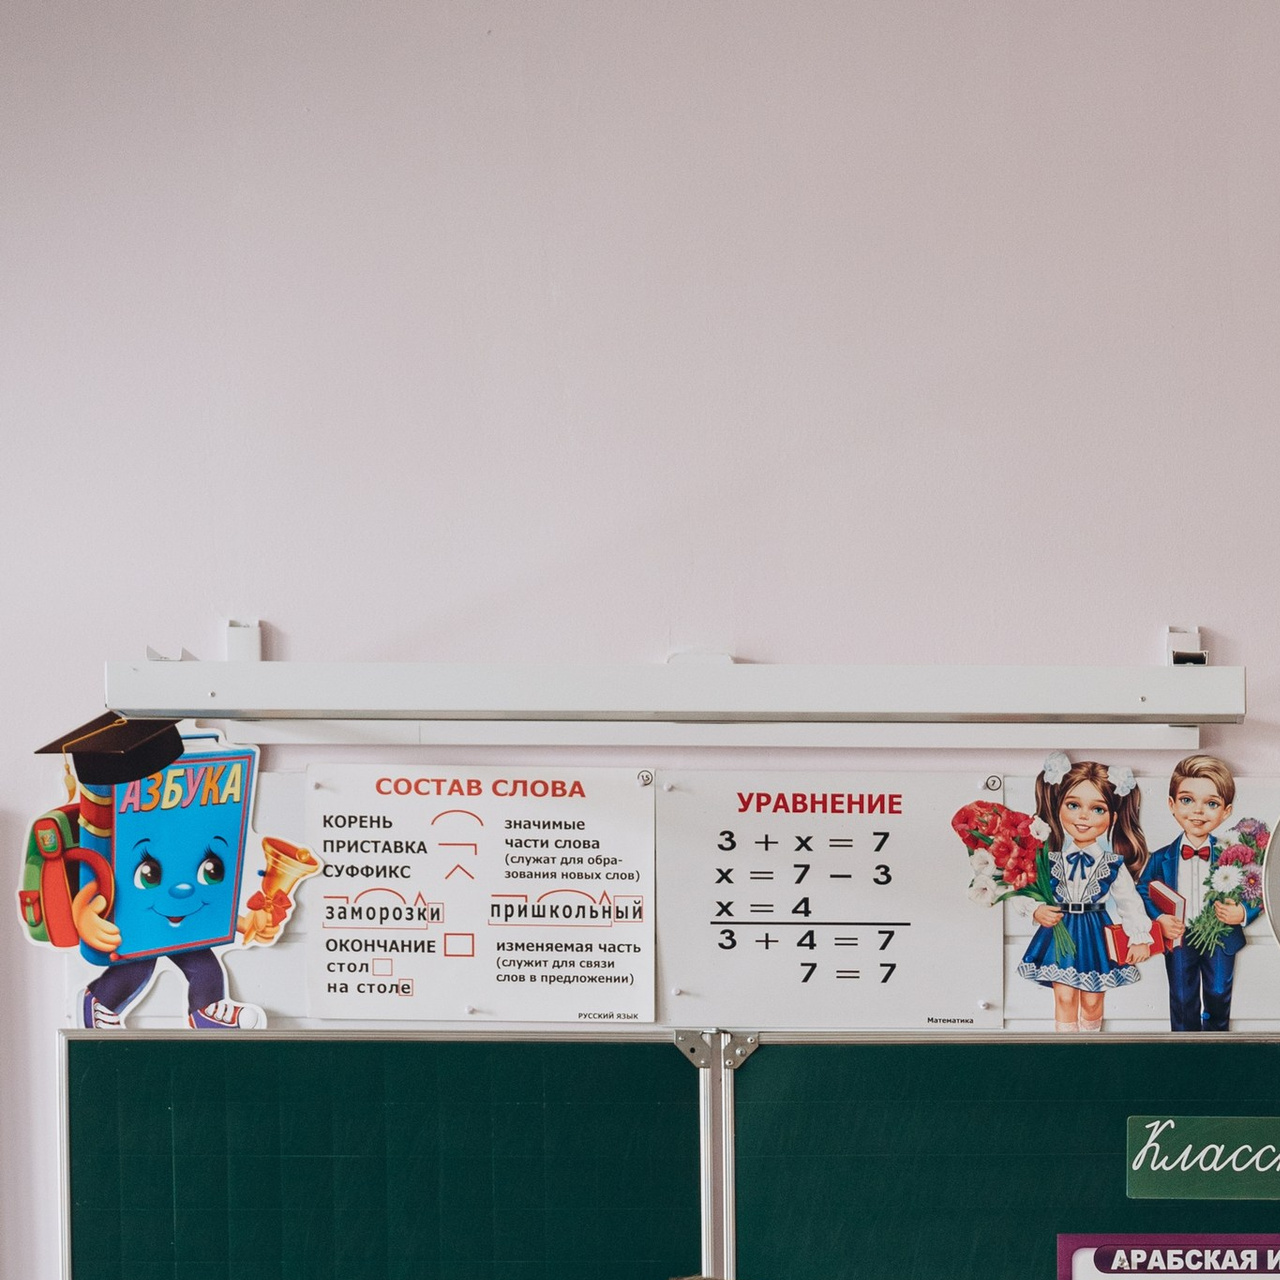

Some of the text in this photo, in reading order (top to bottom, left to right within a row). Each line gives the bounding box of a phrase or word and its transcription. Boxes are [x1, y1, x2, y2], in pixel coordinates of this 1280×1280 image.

[119, 763, 242, 814] АЗБУКА
[375, 777, 586, 798] СОСТАВ СЛОВА
[736, 792, 903, 815] УРАВНЕНИЕ
[323, 815, 393, 829] КОРЕНЬ
[504, 819, 586, 831] значимые
[323, 840, 428, 854] ПРИСТАВКА
[505, 838, 600, 850] части слова
[717, 830, 737, 852] 3
[872, 831, 890, 852] 7
[504, 853, 623, 867] (служат для обра-
[322, 864, 411, 879] СУФФИКС
[504, 870, 641, 882] зования новых слов)
[793, 864, 811, 885] 7
[872, 864, 893, 886] 3
[491, 900, 643, 922] пришкольный
[791, 897, 812, 917] 4
[325, 905, 440, 925] заморозки
[325, 939, 436, 953] ОКОНЧАНИЕ
[496, 941, 641, 953] изменяемая часть
[717, 929, 737, 950] 3
[796, 930, 817, 950] 4
[877, 930, 895, 951] 7
[327, 962, 369, 973] стол
[496, 957, 615, 970] (служит для связи
[496, 973, 634, 985] слов в предложении)
[800, 962, 818, 983] 7
[879, 963, 897, 983] 7
[327, 983, 411, 994] на столе
[578, 1011, 614, 1019] РУССКИЙ
[927, 1016, 974, 1025] Математика
[1110, 1249, 1258, 1272] АРАБСКАЯ
